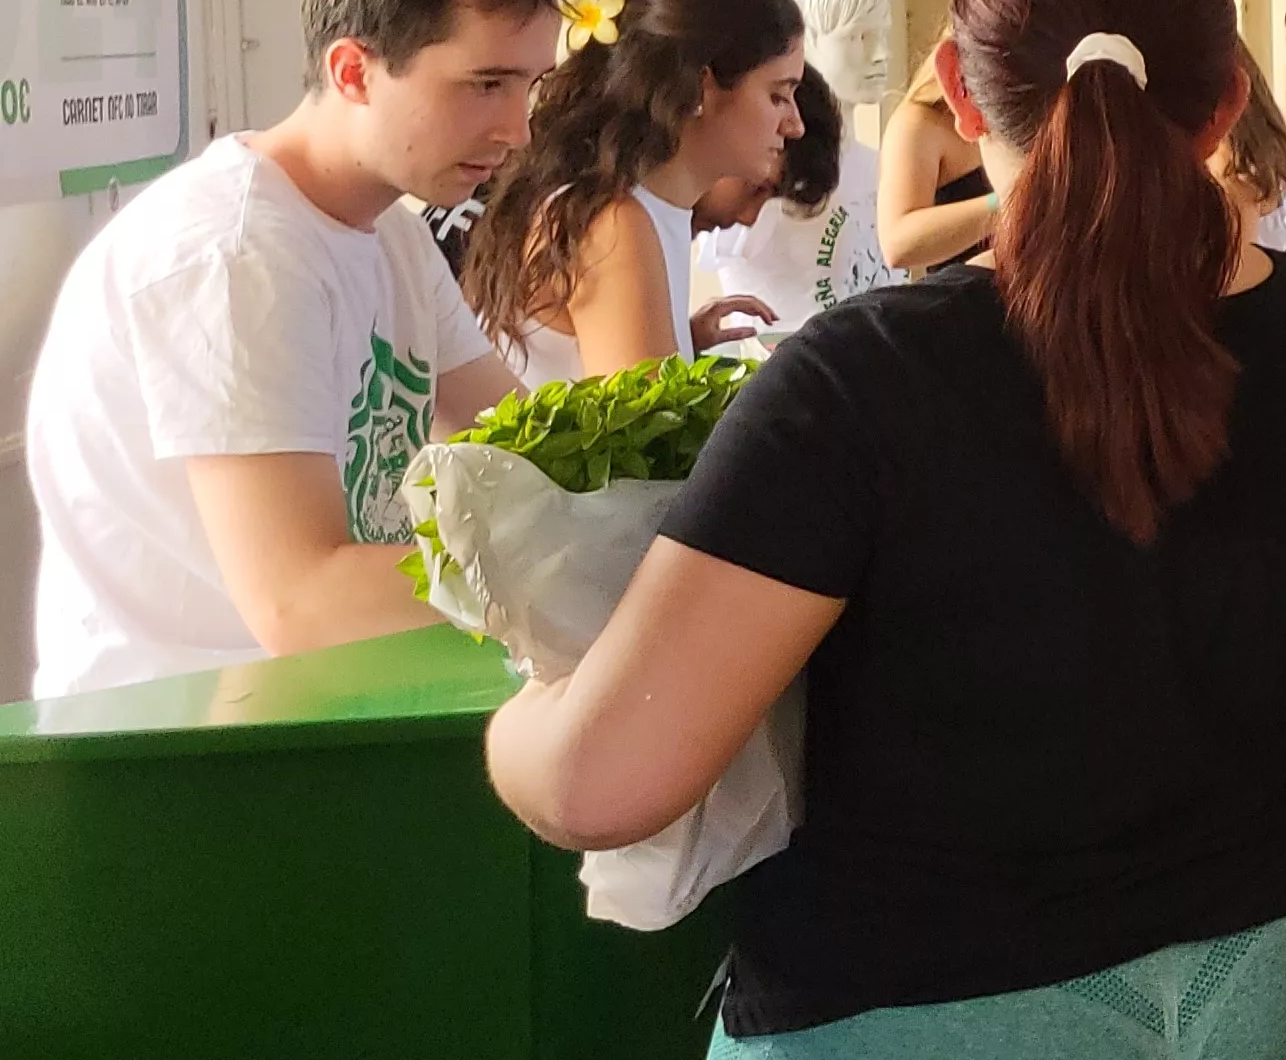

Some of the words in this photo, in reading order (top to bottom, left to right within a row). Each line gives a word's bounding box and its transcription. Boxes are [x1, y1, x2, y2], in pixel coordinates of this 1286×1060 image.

[62, 96, 104, 126] CARNET
[816, 205, 850, 268] ALEGRÍA
[815, 276, 838, 310] EÑA
